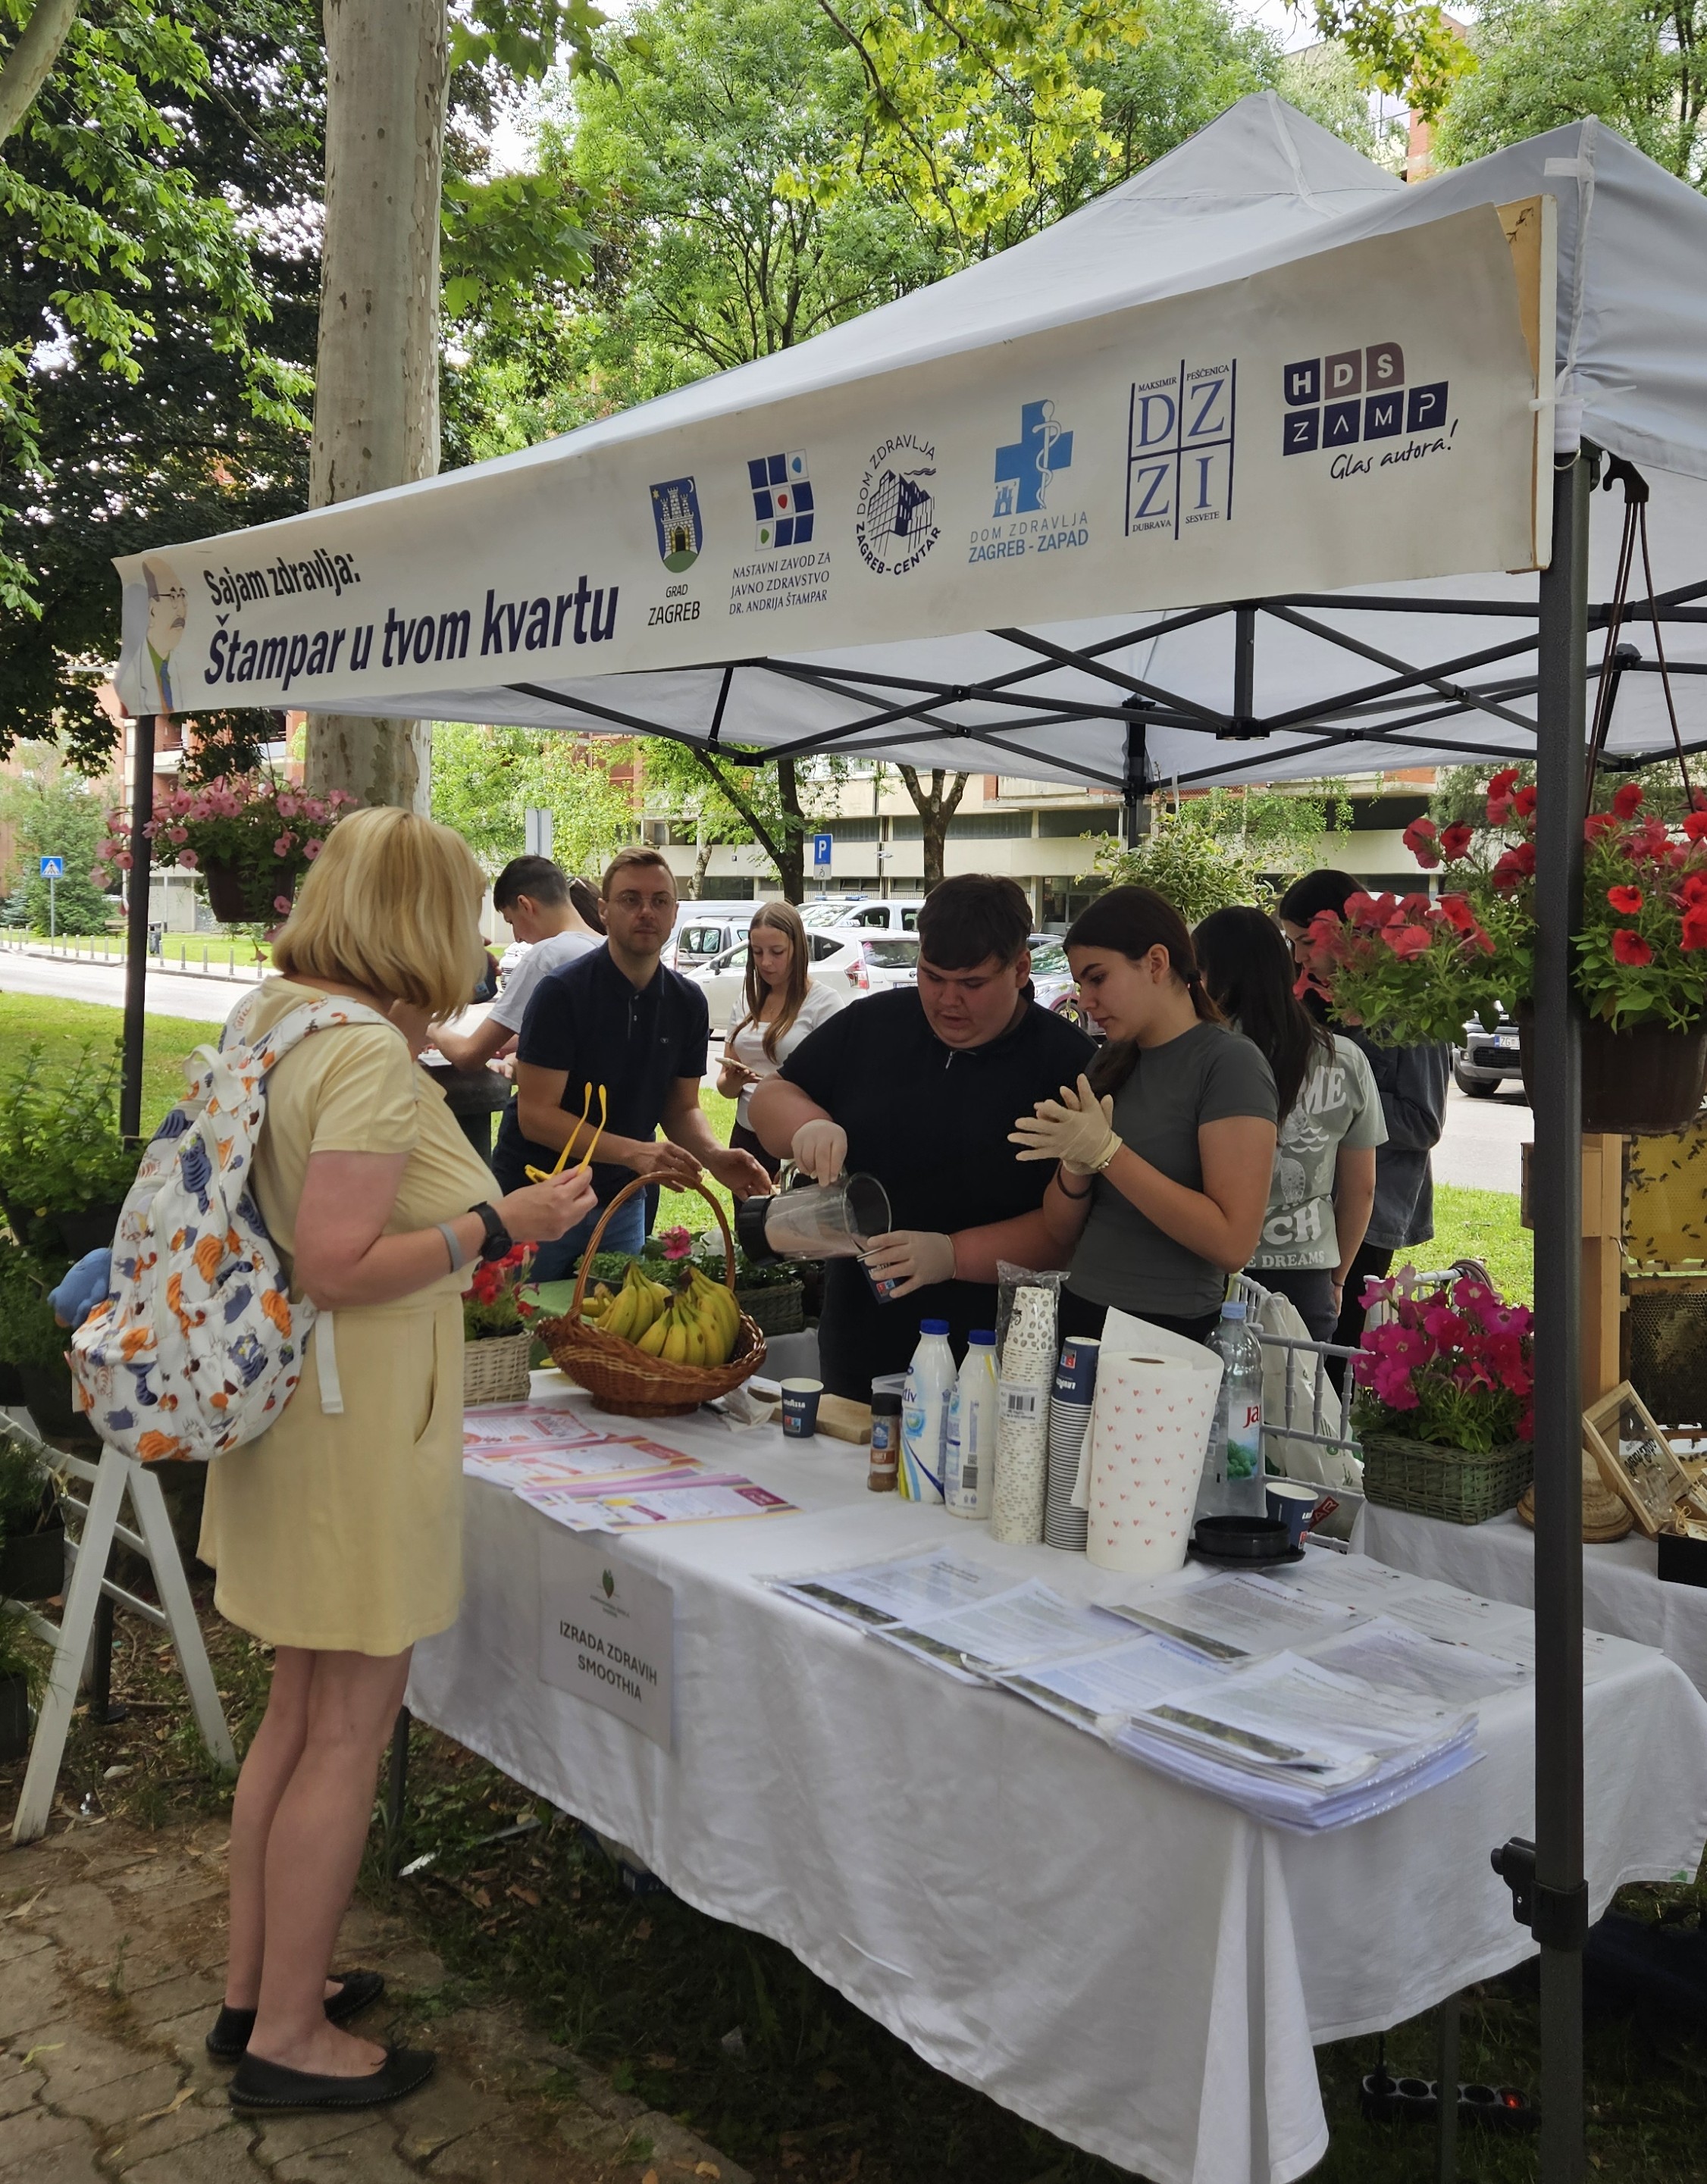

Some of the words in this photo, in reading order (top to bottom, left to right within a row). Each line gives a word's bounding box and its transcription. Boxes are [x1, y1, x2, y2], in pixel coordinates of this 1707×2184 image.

[1139, 377, 1177, 393] MAKSIMIR
[1186, 365, 1229, 380] PEŠČENICA
[1293, 353, 1394, 396] HDS
[1293, 393, 1436, 443] ZAMP
[1330, 454, 1373, 480] Glas
[1380, 418, 1459, 467] autora!
[857, 471, 873, 515] DOM
[869, 434, 936, 470] ZDRAVLJA
[970, 527, 1003, 543] DOM
[1009, 511, 1088, 537] ZDRAVLJA
[1132, 519, 1172, 533] DUBRAVA
[1185, 511, 1220, 524] SESVETE
[969, 539, 1026, 564] ZAGREB
[1036, 528, 1089, 552] ZAPAD
[732, 561, 779, 579] NASTAVNI
[781, 554, 816, 571] ZAVOD
[818, 552, 831, 565] ZA
[203, 567, 268, 612] Sajam
[268, 549, 362, 597] zdravlja:
[666, 584, 688, 599] GRAD
[731, 581, 764, 599] JAVNO
[766, 569, 830, 592] ZDRAVSTVO
[648, 600, 700, 626] ZAGREB
[730, 602, 744, 615] DR.
[747, 596, 784, 612] ANDRIJA
[785, 589, 828, 607] ŠTAMPAR
[204, 614, 346, 690] Štampar
[349, 625, 374, 671] u
[382, 607, 471, 668] tvom
[480, 574, 619, 656] kvartu
[819, 840, 827, 859] P
[1261, 1250, 1325, 1268] DREAMS
[1242, 1404, 1261, 1428] Ja
[559, 1620, 604, 1654] IZRADA
[606, 1643, 657, 1687] ZDRAVIH
[578, 1654, 642, 1702] SMOOTHIA
